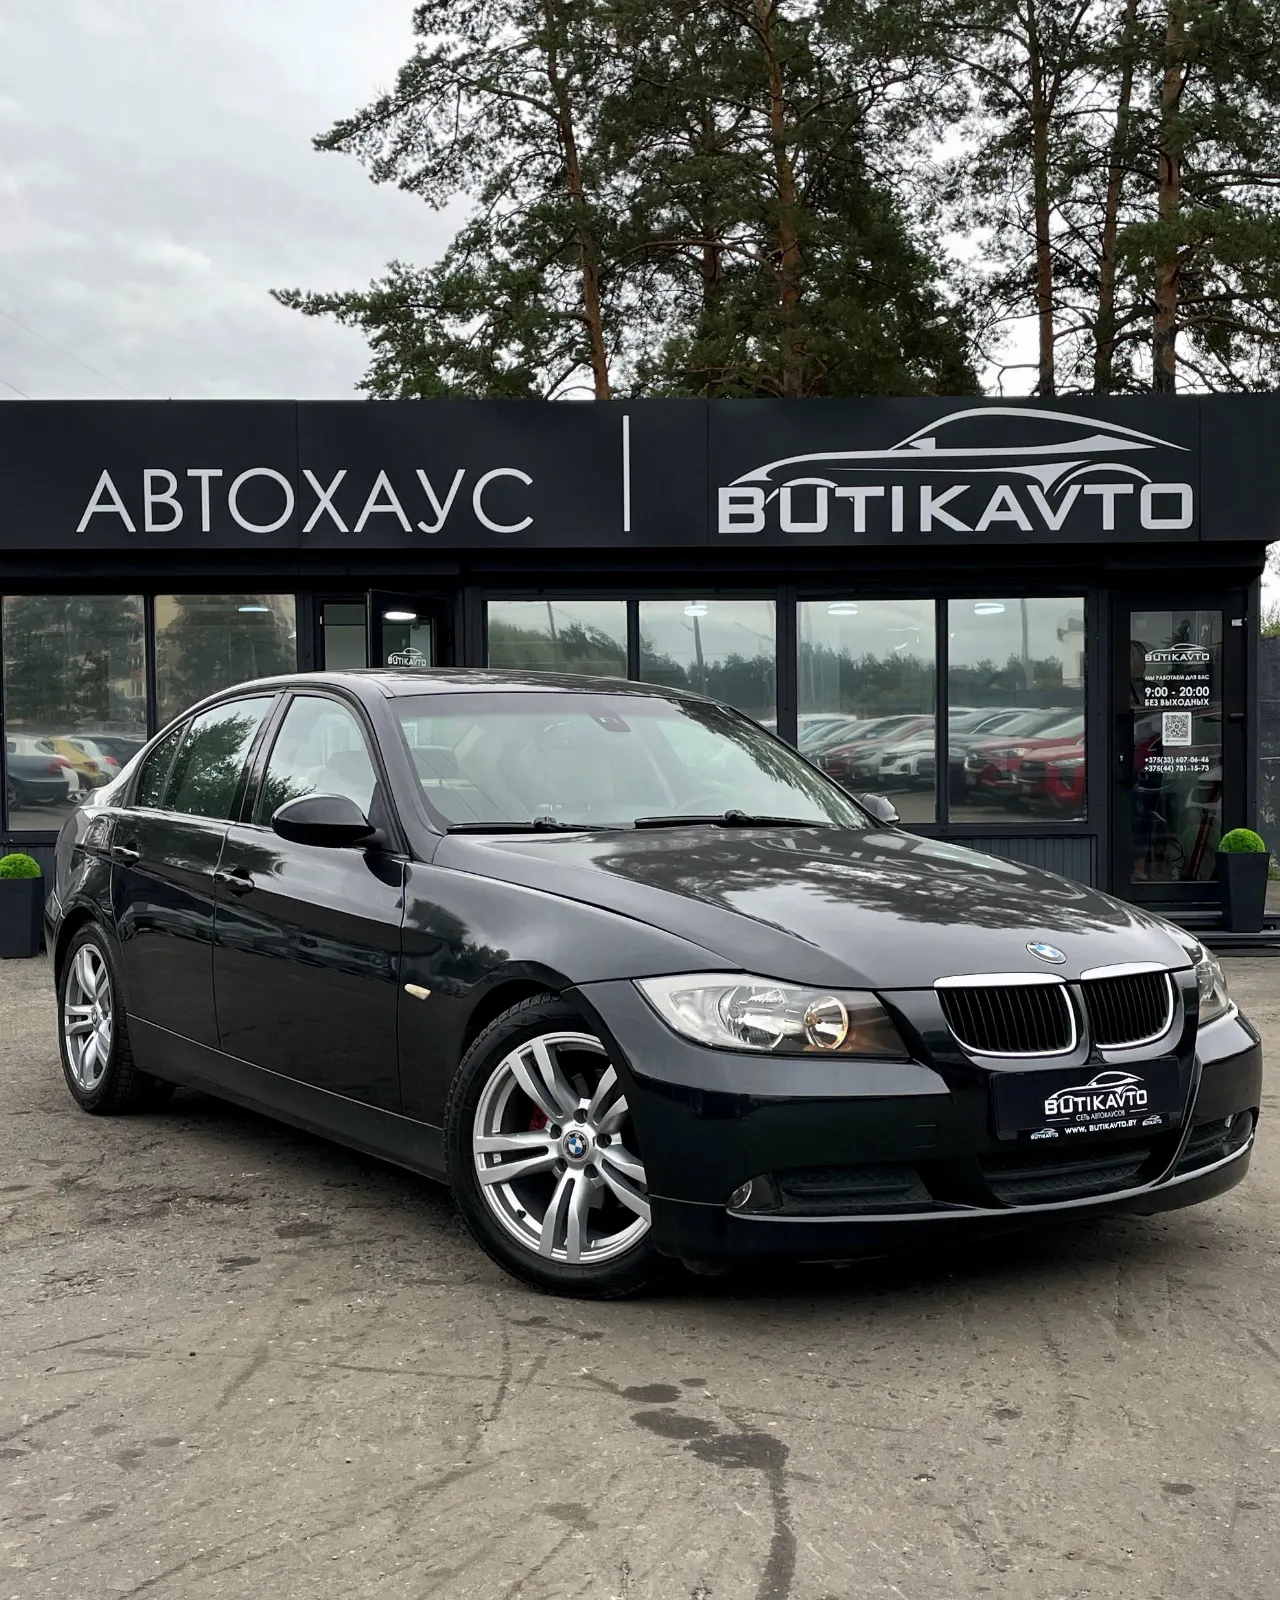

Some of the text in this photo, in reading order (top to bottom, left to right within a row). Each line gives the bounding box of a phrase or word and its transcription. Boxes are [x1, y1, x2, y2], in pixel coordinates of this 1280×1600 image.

[76, 467, 535, 534] АВТОХАУС
[718, 483, 1194, 533] BUTIKAVTO
[1144, 653, 1210, 661] BUTIKAVTO
[1144, 687, 1168, 697] 9:00
[1179, 686, 1210, 697] 20:00
[1160, 698, 1210, 706] ВЫХОДНЫХ
[1144, 756, 1210, 764] +375(33) 607-06-46
[1144, 764, 1210, 773] +375(44) 781-15-73
[1044, 1090, 1148, 1115] BUTIKAVTO
[1075, 1114, 1090, 1122] СЕТЬ
[1064, 1119, 1137, 1134] WWW. BUTIKAVTO.BY
